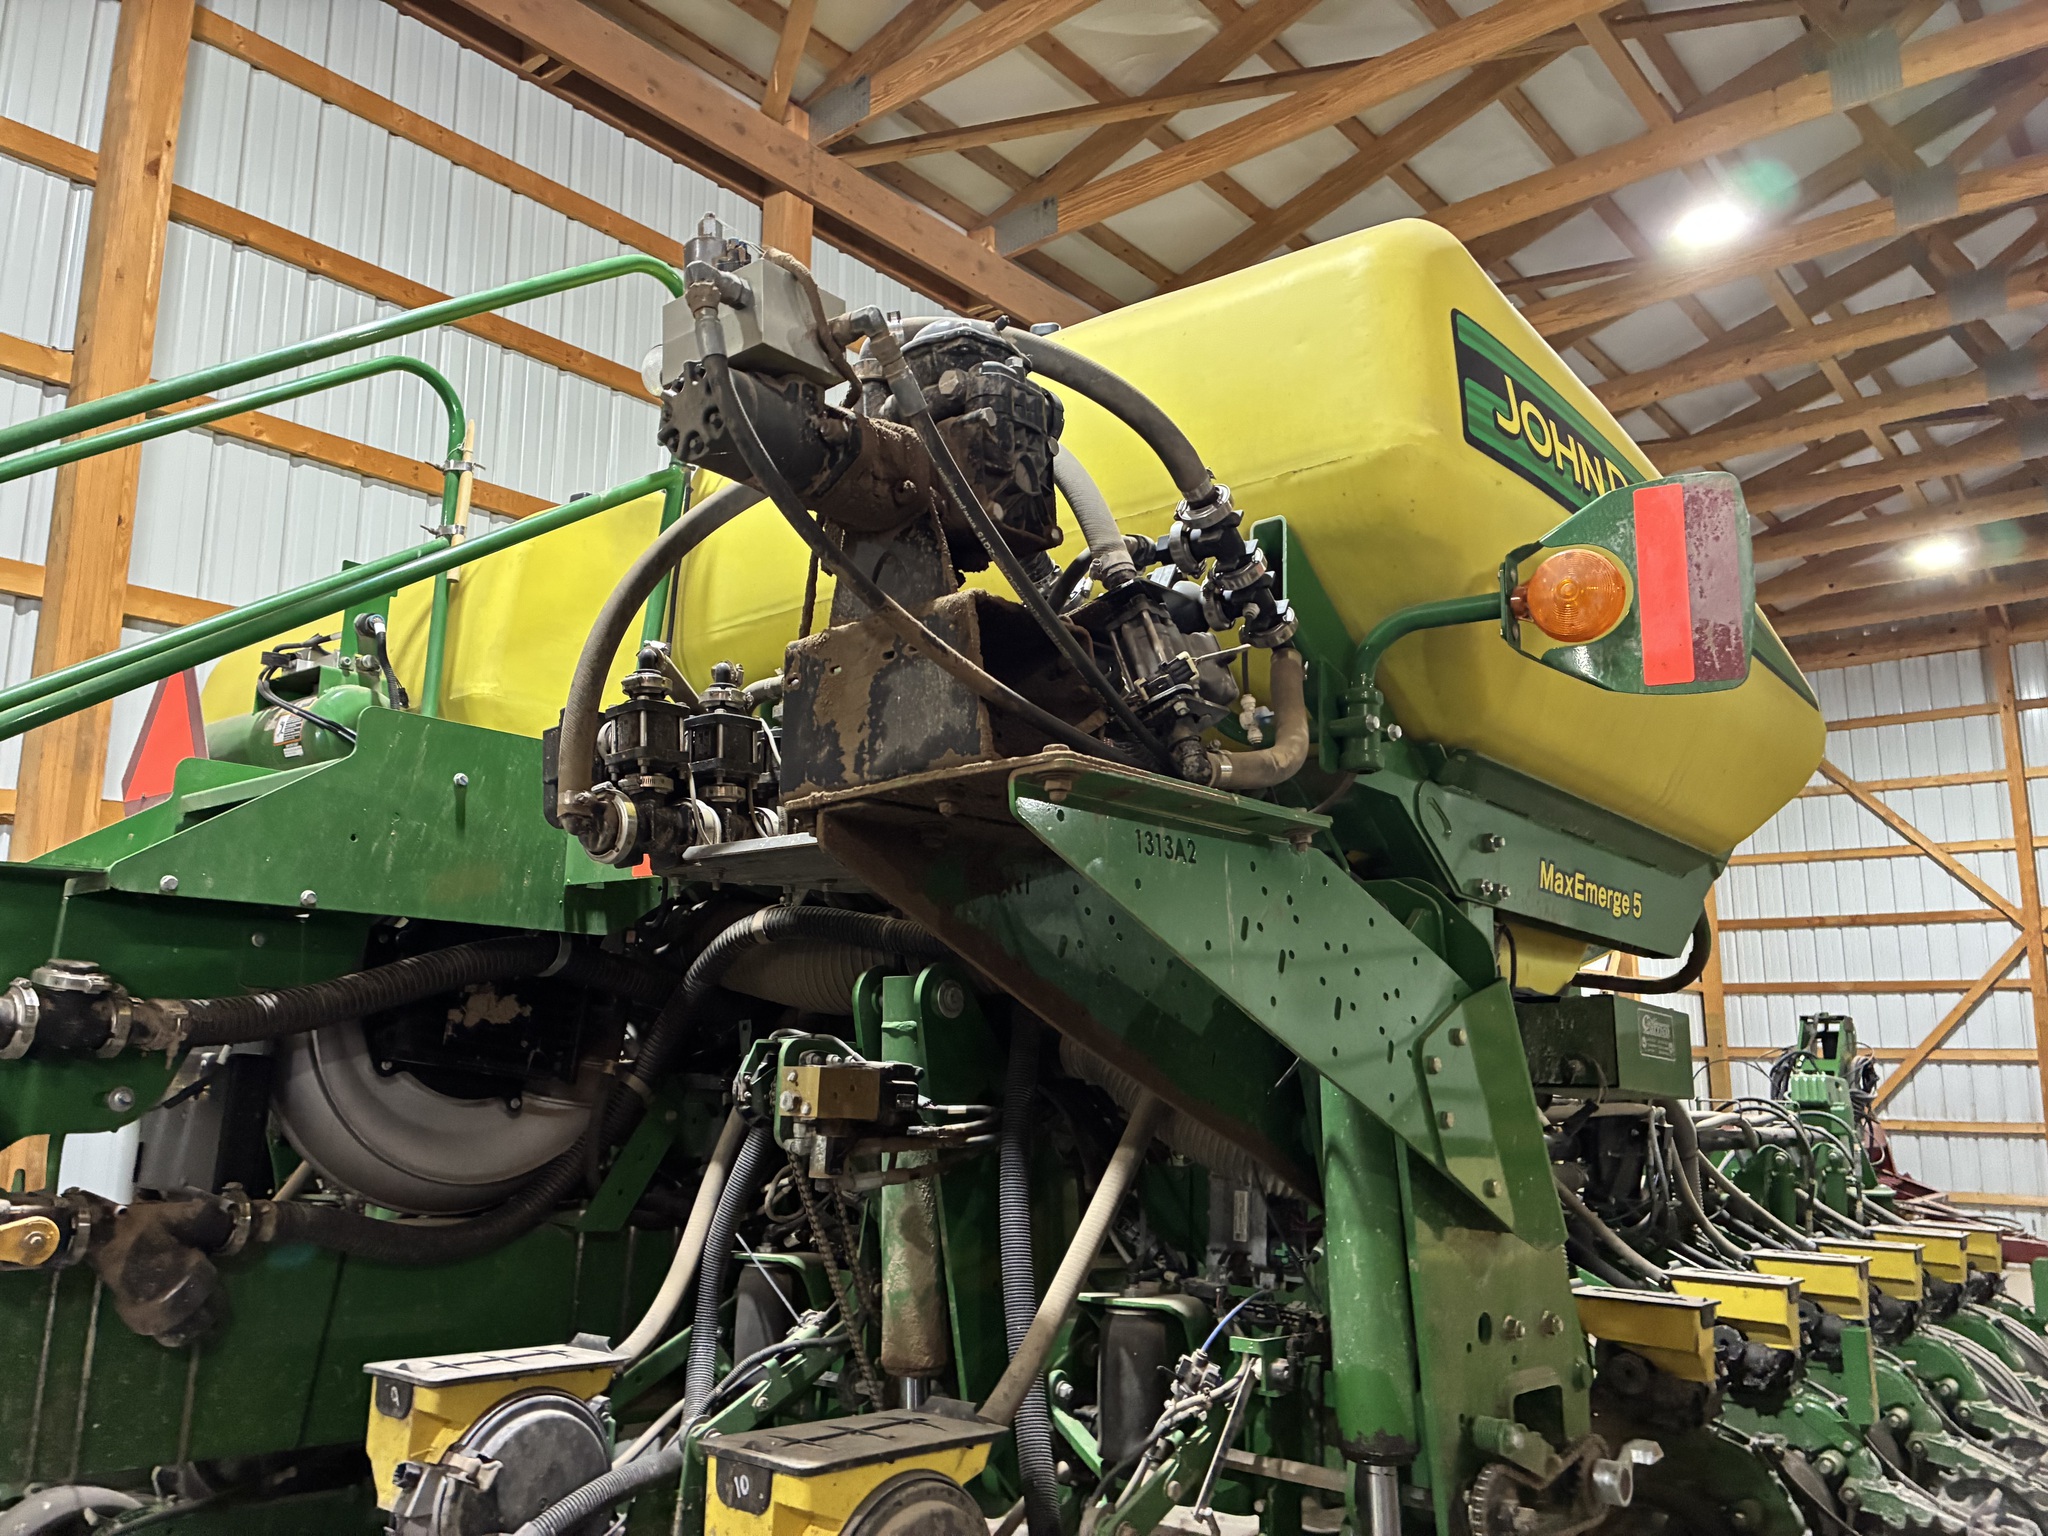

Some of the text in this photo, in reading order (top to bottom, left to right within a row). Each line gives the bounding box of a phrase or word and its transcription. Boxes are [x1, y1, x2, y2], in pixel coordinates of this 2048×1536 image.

[1496, 374, 1606, 497] JOHN
[1135, 829, 1196, 864] 1313A2
[1540, 860, 1643, 919] MaxEmerge 5
[733, 1474, 750, 1499] 10
